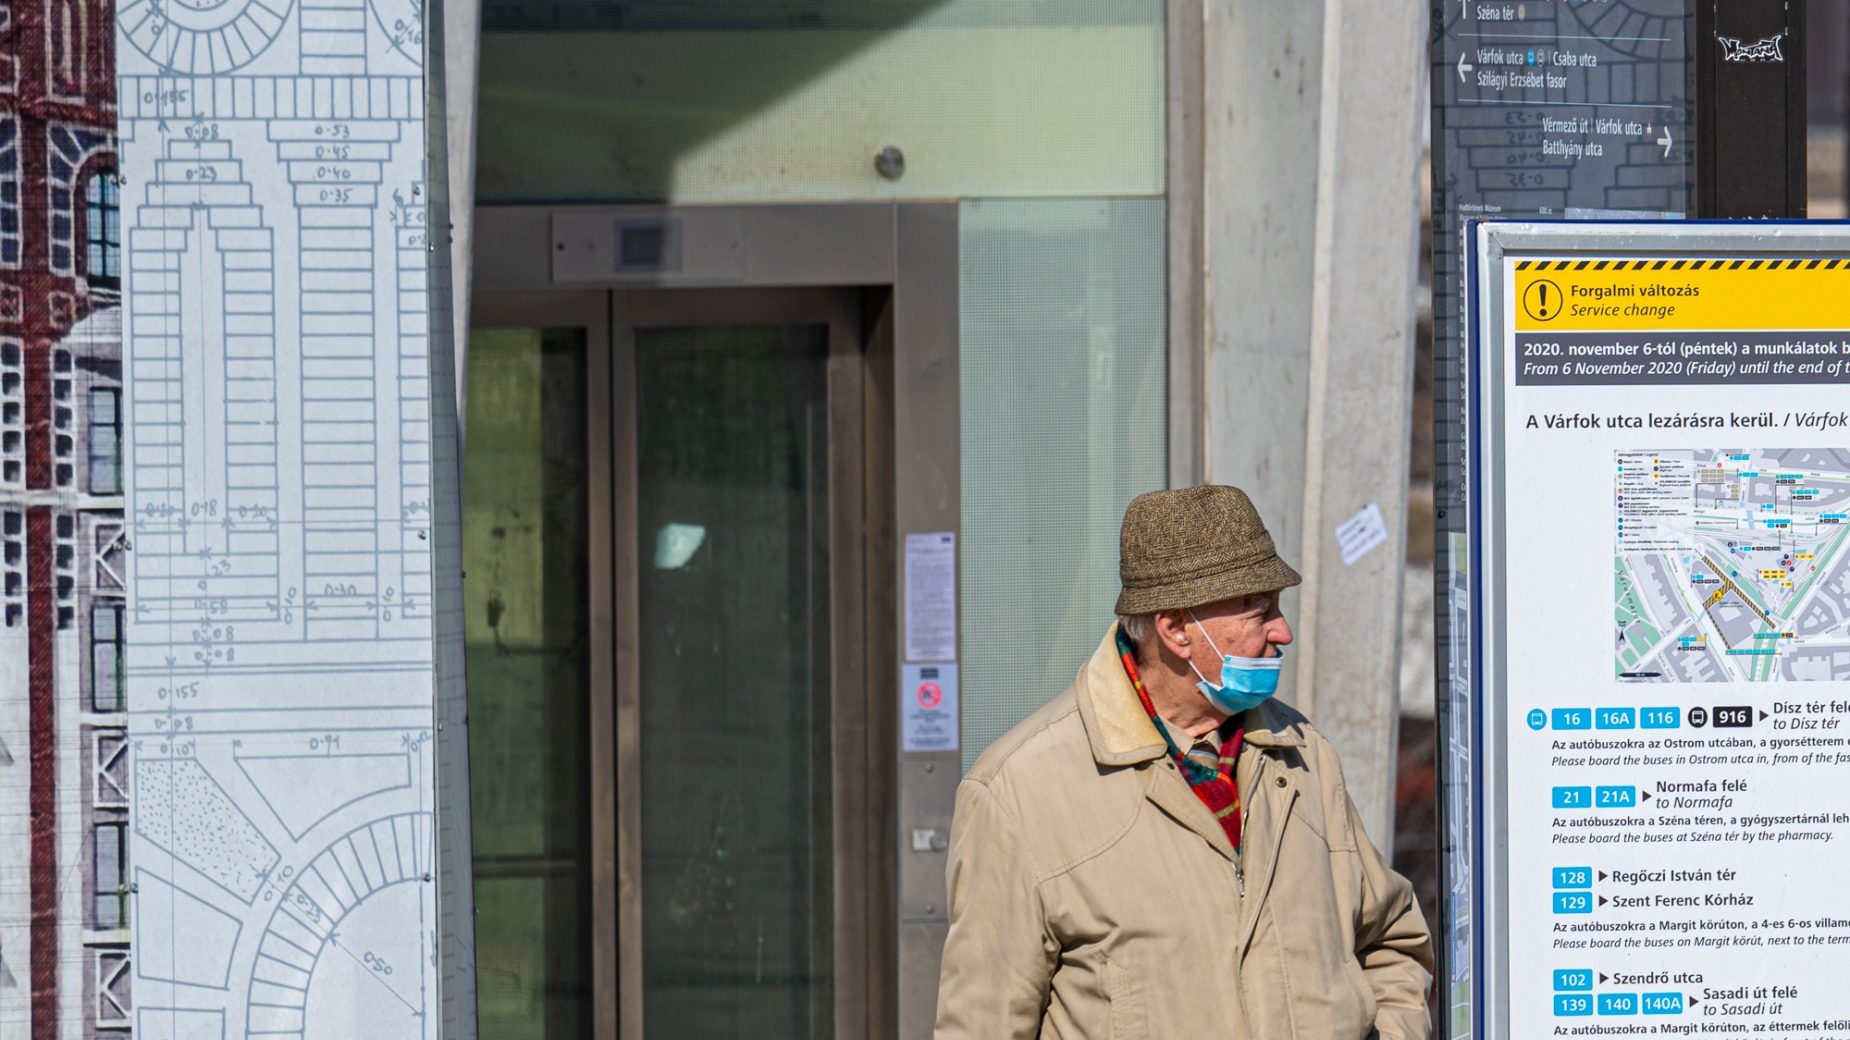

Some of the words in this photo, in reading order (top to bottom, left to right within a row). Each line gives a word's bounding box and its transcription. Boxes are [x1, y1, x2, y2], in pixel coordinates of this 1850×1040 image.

[1477, 5, 1500, 20] Széna
[1502, 7, 1514, 20] tér
[1477, 48, 1504, 64] Várfok
[1506, 53, 1524, 65] utca
[1553, 50, 1577, 66] Csaba
[1579, 53, 1597, 67] utca
[1477, 71, 1508, 91] Szilágyi
[1510, 72, 1544, 88] Erzsébet
[1546, 72, 1567, 88] fasor
[1542, 116, 1577, 133] Vérmező
[1579, 118, 1589, 134] út
[1595, 118, 1622, 135] Várfok
[1625, 122, 1643, 135] utca
[1542, 139, 1583, 160] Batthyány
[1585, 142, 1603, 156] utca
[1571, 284, 1634, 300] Forgalmi
[1639, 283, 1699, 297] változás
[1570, 303, 1620, 316] Service
[1624, 303, 1675, 319] change
[1524, 343, 1564, 356] 2020.
[1569, 342, 1639, 356] november
[1643, 342, 1675, 355] 6-tól
[1680, 341, 1737, 358] (péntek)
[1741, 345, 1750, 355] a
[1755, 341, 1838, 354] munkálatok
[1524, 362, 1558, 375] From
[1562, 362, 1571, 375] 6
[1575, 361, 1645, 375] November
[1647, 361, 1682, 374] 2020
[1686, 361, 1736, 378] (Friday)
[1740, 361, 1770, 374] until
[1773, 360, 1795, 373] the
[1798, 360, 1824, 373] end
[1827, 360, 1843, 377] of
[1526, 415, 1539, 429] A
[1544, 413, 1600, 429] Várfok
[1607, 415, 1642, 428] utca
[1649, 412, 1724, 428] lezárásra
[1730, 412, 1778, 428] kerül.
[1795, 411, 1848, 431] Várfok
[1774, 701, 1802, 714] Dísz
[1806, 701, 1826, 713] tér
[1564, 712, 1581, 725] 16
[1603, 711, 1630, 725] 16A
[1649, 710, 1673, 724] 116
[1719, 709, 1747, 724] 916
[1773, 719, 1787, 730] to
[1791, 717, 1818, 730] Dísz
[1822, 716, 1840, 729] tér
[1552, 740, 1566, 750] Az
[1569, 738, 1645, 749] autóbuszokra
[1664, 738, 1705, 748] Ostrom
[1708, 737, 1756, 748] utcában,
[1760, 739, 1766, 747] a
[1770, 736, 1844, 750] gyorsétterem
[1657, 779, 1717, 793] Normafa
[1721, 779, 1747, 792] felé
[1564, 790, 1579, 804] 21
[1602, 789, 1630, 803] 21A
[1656, 798, 1670, 809] to
[1674, 795, 1733, 811] Normafa
[1552, 817, 1566, 827] Az
[1569, 816, 1645, 827] autóbuszokra
[1648, 818, 1655, 826] a
[1658, 815, 1691, 826] Széna
[1694, 815, 1726, 826] téren,
[1730, 817, 1737, 825] a
[1740, 813, 1829, 827] gyógyszertárnál
[1552, 833, 1586, 844] Please
[1588, 833, 1621, 843] board
[1623, 832, 1640, 843] the
[1643, 832, 1673, 843] buses
[1676, 833, 1687, 842] at
[1690, 832, 1722, 842] Széna
[1725, 831, 1740, 841] tér
[1742, 831, 1756, 844] by
[1758, 830, 1775, 841] the
[1777, 830, 1833, 843] pharmacy.
[1561, 871, 1585, 884] 128
[1613, 869, 1666, 885] Regőczi
[1671, 868, 1712, 882] István
[1716, 868, 1736, 881] tér
[1561, 895, 1586, 909] 129
[1613, 895, 1650, 907] Szent
[1655, 895, 1700, 907] Ferenc
[1705, 893, 1753, 906] Kórház
[1561, 973, 1585, 986] 102
[1613, 971, 1669, 984] Szendrő
[1673, 973, 1703, 984] utca
[1703, 987, 1748, 1000] Sasadi
[1753, 986, 1767, 999] út
[1772, 986, 1797, 999] felé
[1562, 998, 1587, 1011] 139
[1606, 997, 1631, 1011] 140
[1645, 996, 1681, 1010] 140A
[1703, 1005, 1717, 1016] to
[1721, 1002, 1766, 1015] Sasadi
[1769, 1002, 1783, 1015] út
